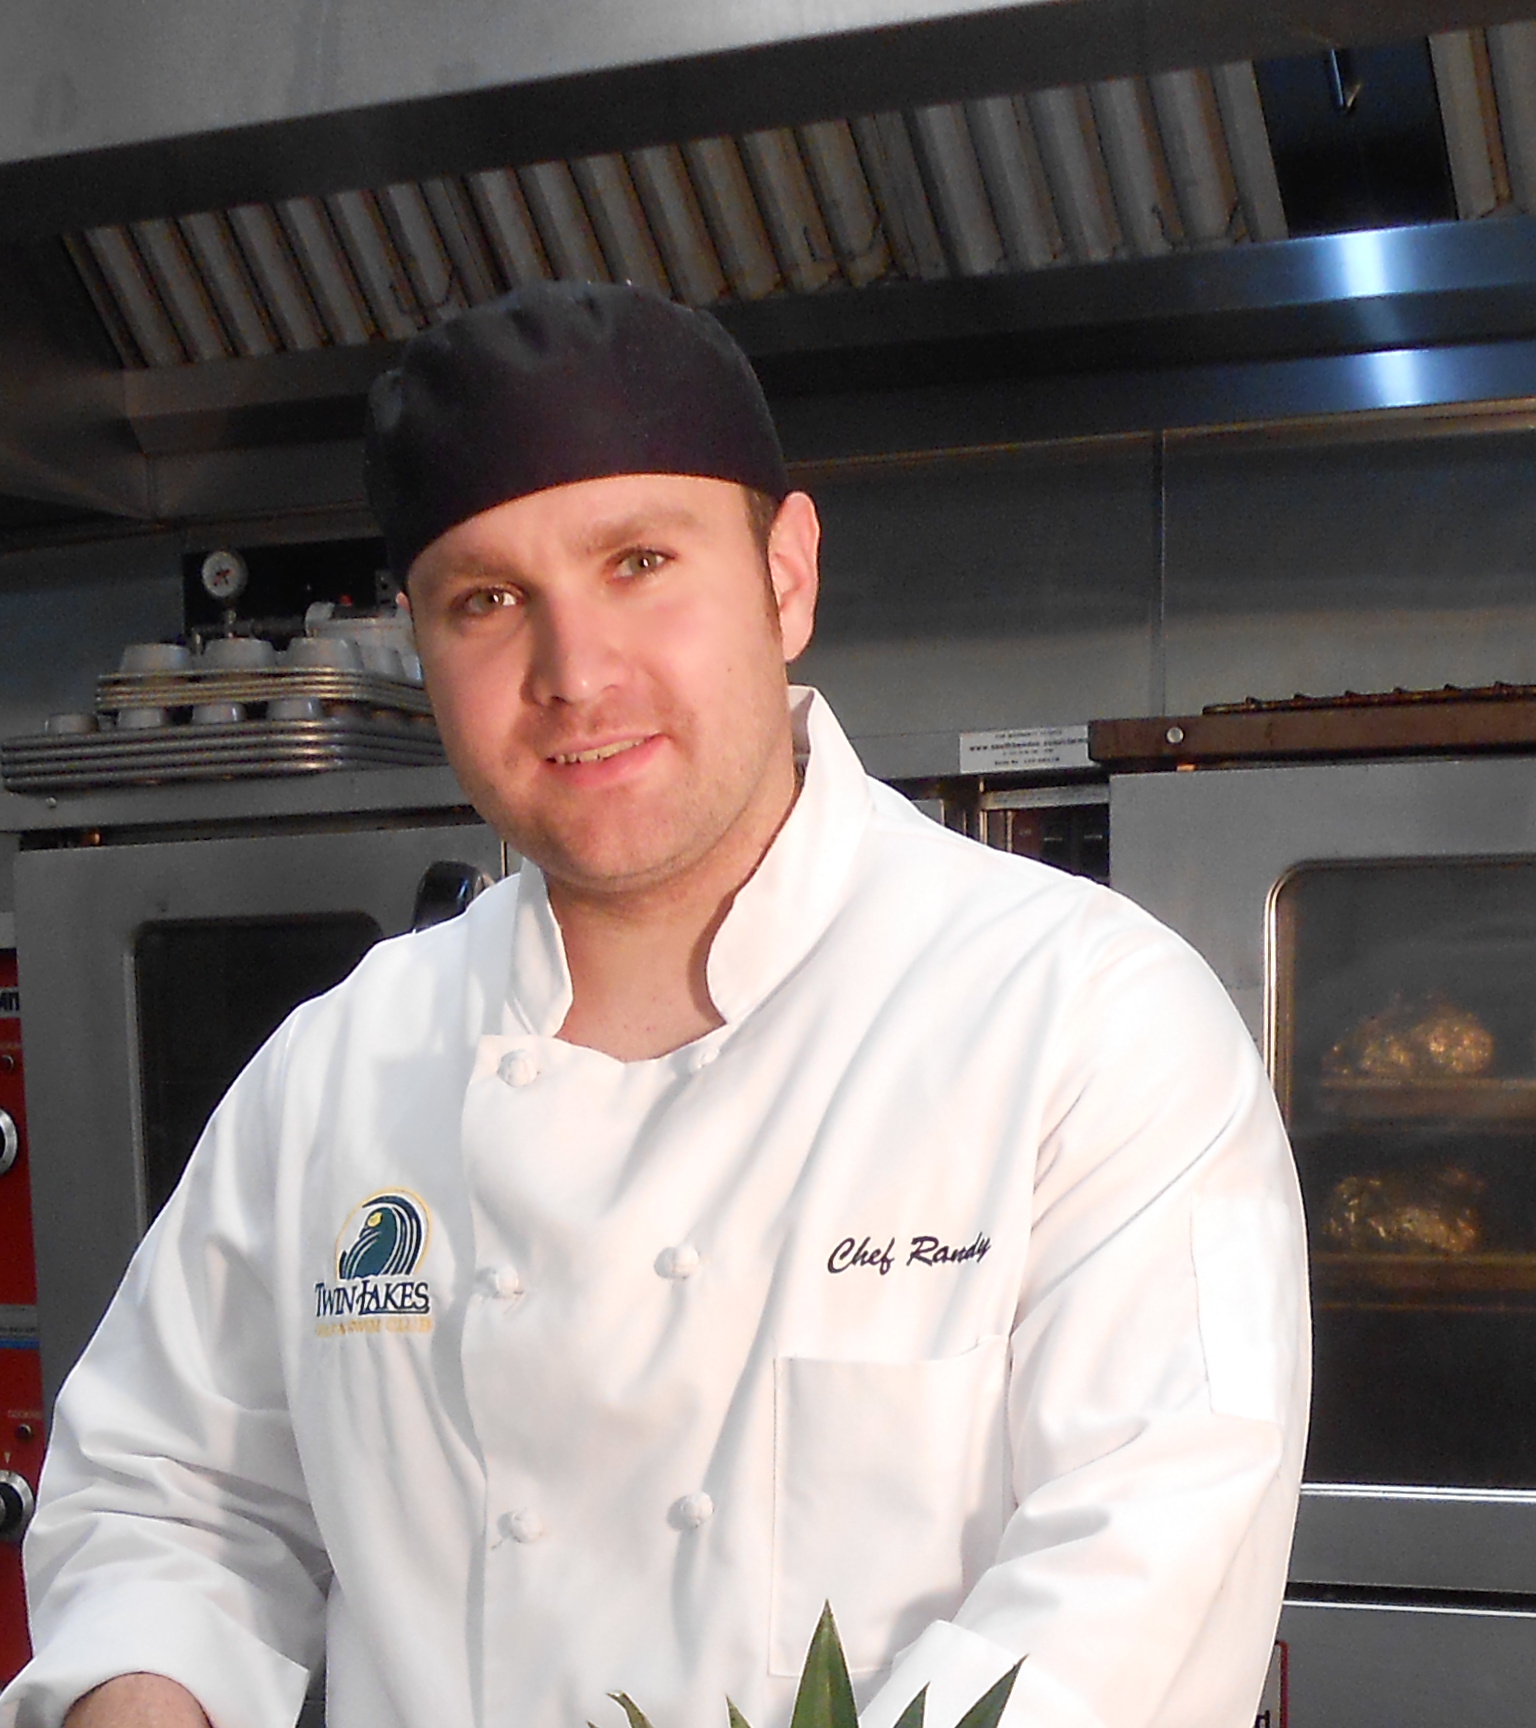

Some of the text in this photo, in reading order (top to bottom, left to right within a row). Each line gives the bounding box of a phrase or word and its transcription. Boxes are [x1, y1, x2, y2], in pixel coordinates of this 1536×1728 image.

[827, 1231, 992, 1275] Chef Randy
[315, 1279, 430, 1317] TWIN LAKES
